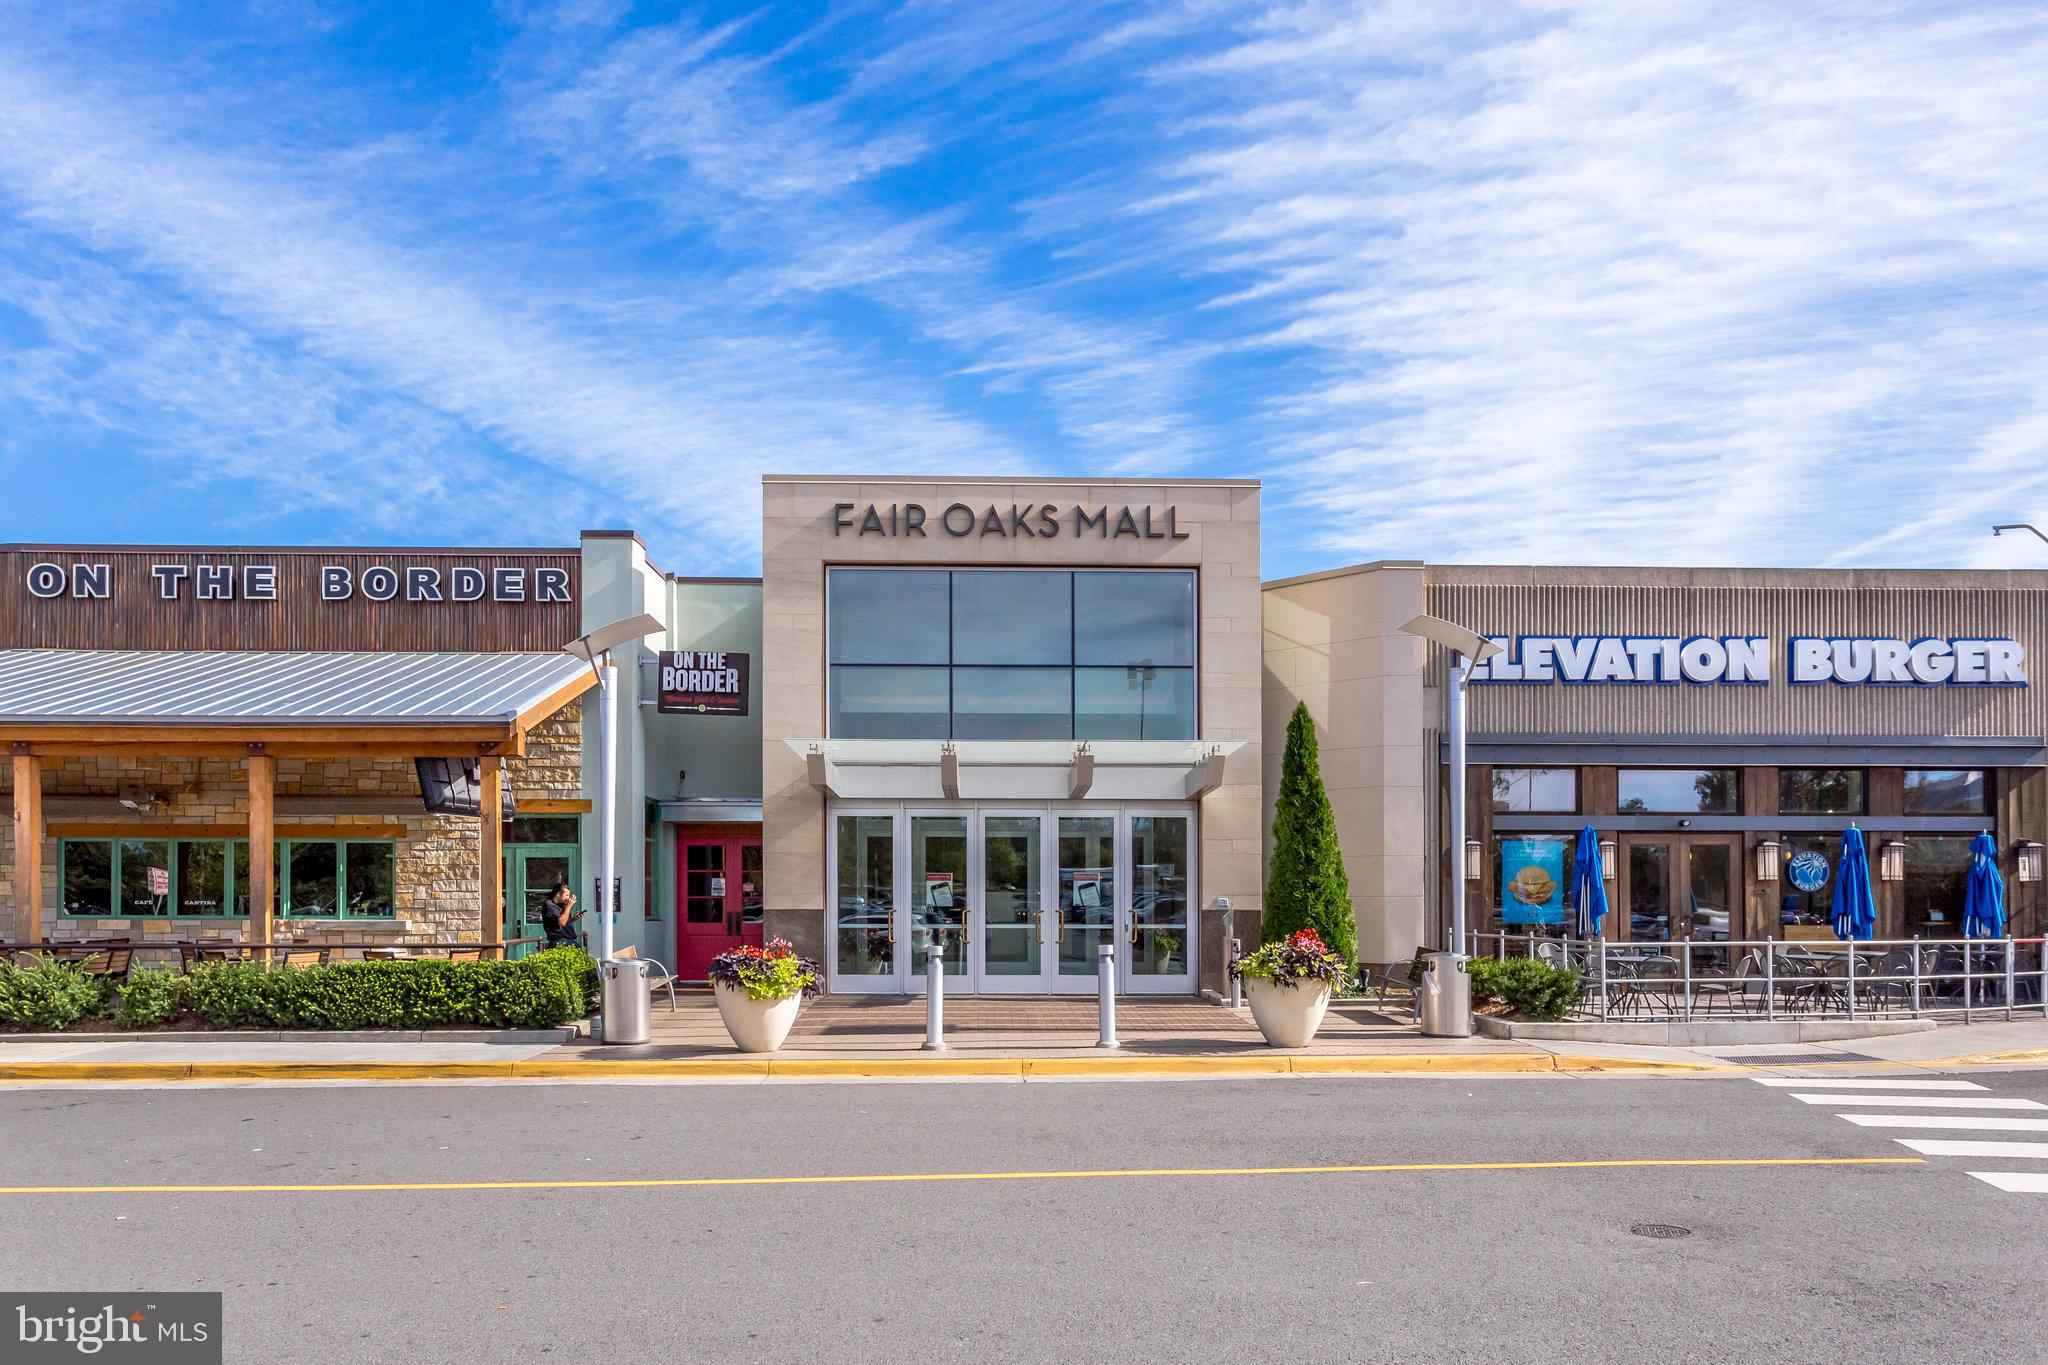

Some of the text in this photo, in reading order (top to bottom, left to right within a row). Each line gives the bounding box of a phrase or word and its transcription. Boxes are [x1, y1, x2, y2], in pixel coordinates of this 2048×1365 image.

[834, 502, 1190, 539] FAIR OAKS MALL
[26, 563, 572, 602] ON THE BORDER
[673, 651, 727, 670] ON THE
[1791, 637, 2026, 684] BURGER
[663, 666, 739, 693] BORDER
[1792, 852, 1828, 868] ELEVATION
[1795, 880, 1824, 890] BURGER
